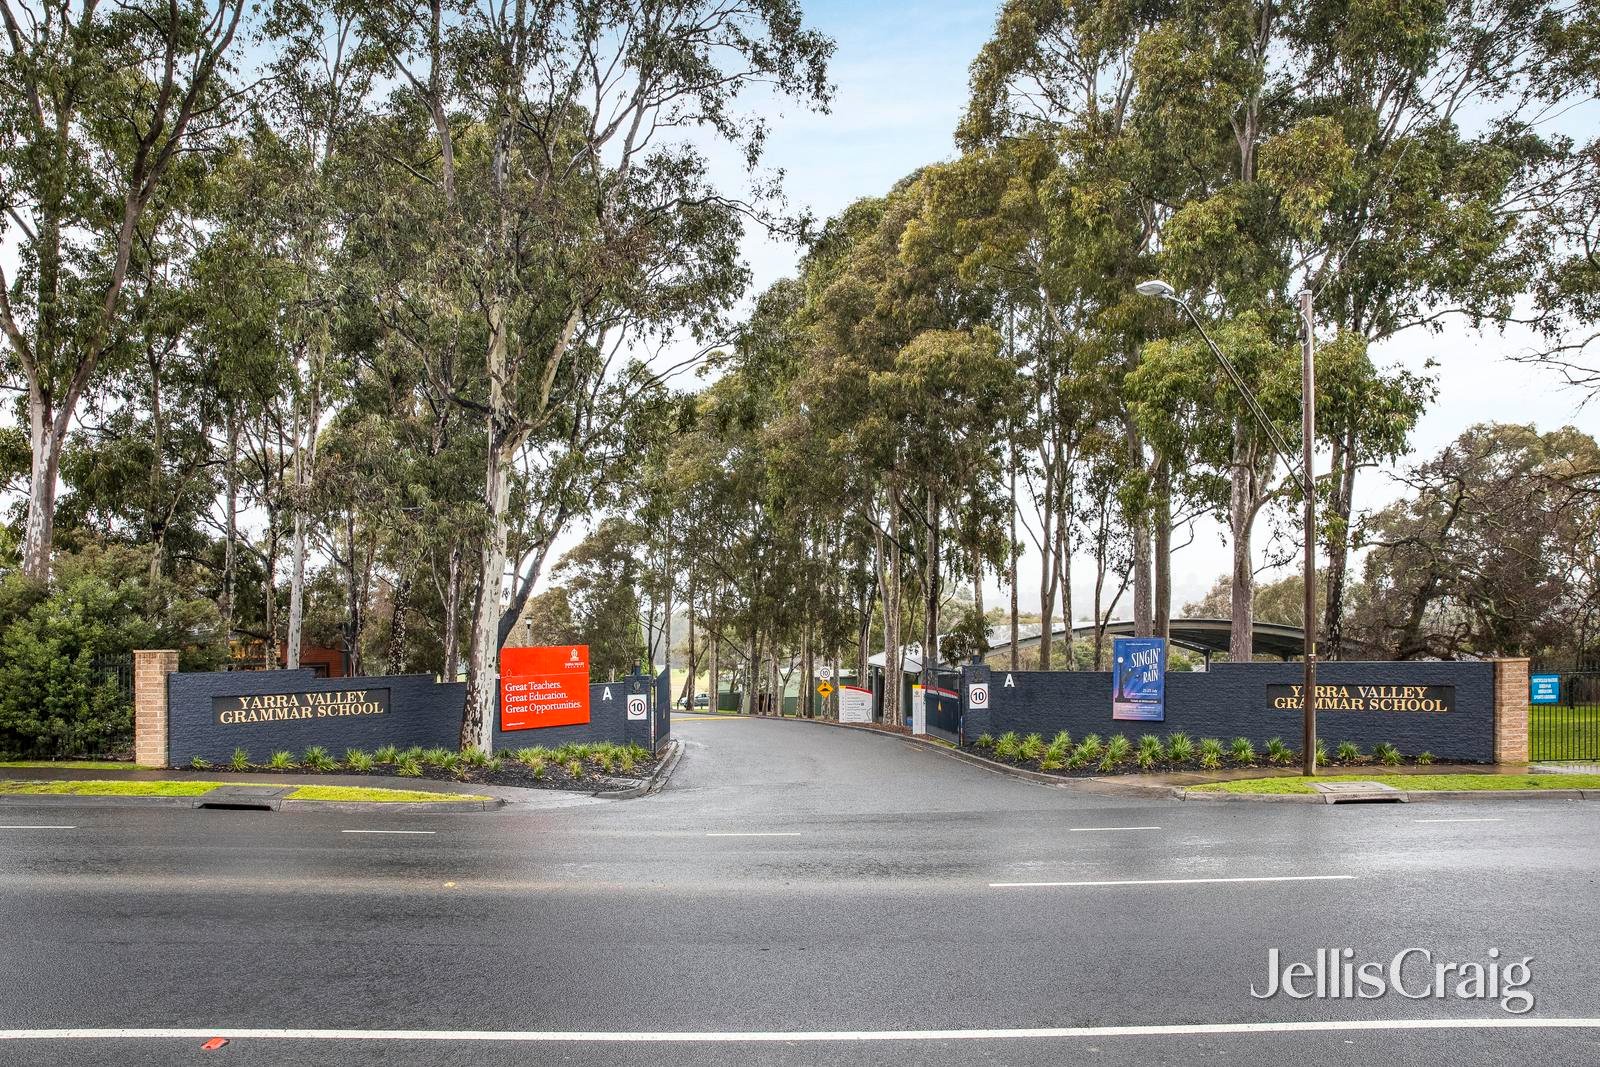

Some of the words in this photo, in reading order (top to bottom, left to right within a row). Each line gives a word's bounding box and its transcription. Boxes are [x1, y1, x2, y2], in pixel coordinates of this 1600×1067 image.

[1131, 648, 1160, 668] SINGIN'
[1004, 673, 1015, 688] A
[1143, 670, 1158, 683] RAIN
[505, 682, 527, 692] Great
[529, 681, 561, 691] Teachers.
[602, 686, 613, 700] A
[1291, 685, 1349, 698] YRRA
[1357, 686, 1428, 699] VALLEY
[238, 694, 300, 710] YARRA
[306, 690, 367, 706] VALLEY
[505, 693, 528, 703] Great
[529, 691, 568, 701] Education.
[973, 691, 984, 701] 10
[505, 704, 528, 714] Great
[529, 701, 582, 714] Opportunities.
[631, 702, 643, 712] 10
[1369, 699, 1448, 712] SCHOOL
[220, 706, 313, 724] GRAMMAR
[317, 702, 384, 718] SCHOOL
